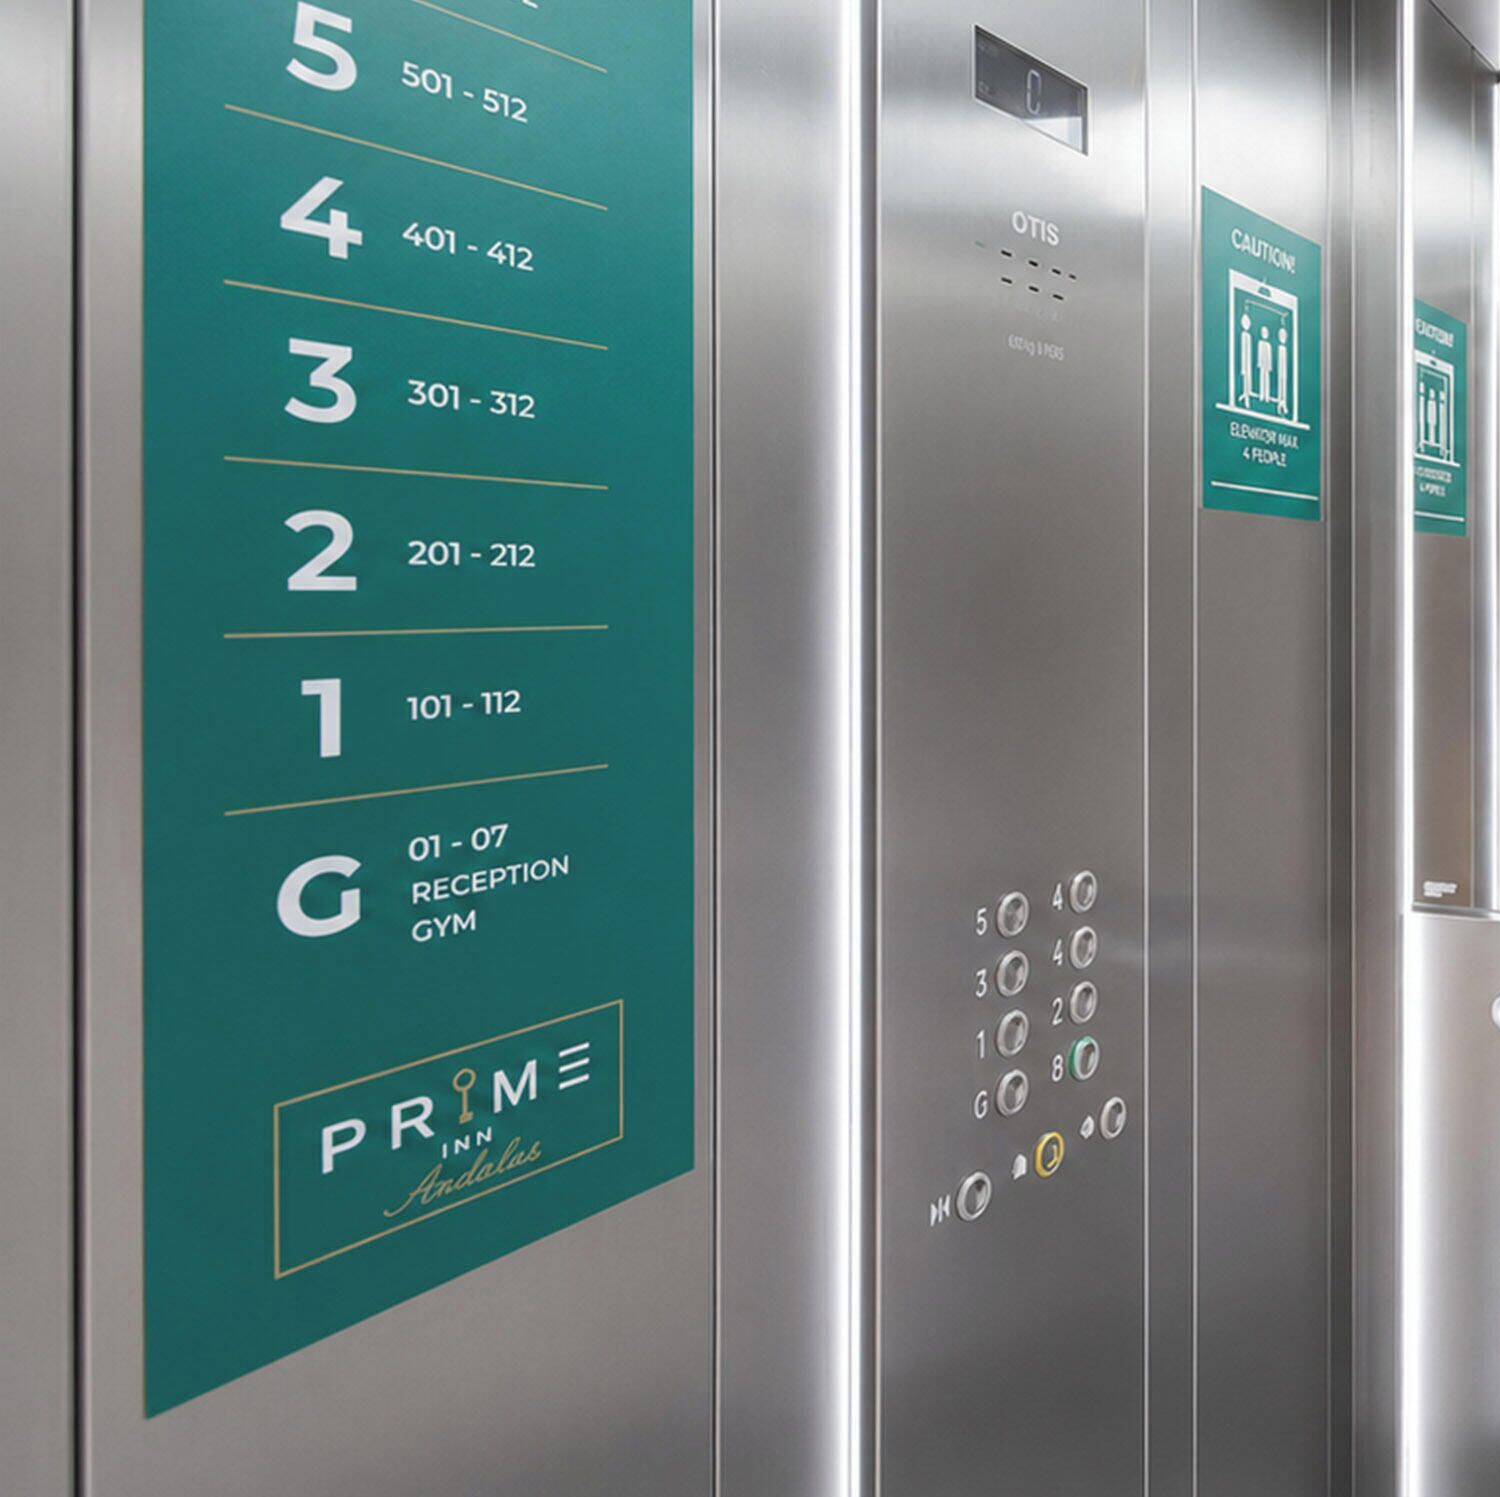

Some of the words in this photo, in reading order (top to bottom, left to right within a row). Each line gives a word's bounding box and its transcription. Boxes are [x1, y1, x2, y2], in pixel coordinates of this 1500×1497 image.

[286, 1, 358, 91] 5
[401, 61, 453, 99] 501
[463, 90, 475, 98] -
[482, 87, 528, 123] 512
[280, 176, 363, 260] 4
[402, 222, 456, 255] 401
[486, 242, 534, 272] 412
[1012, 211, 1060, 246] OTIS
[1231, 228, 1296, 275] CAUTION!
[284, 338, 357, 424] 3
[407, 379, 460, 410] 301
[489, 391, 535, 419] 312
[284, 509, 357, 592] 2
[408, 540, 460, 566] 201
[490, 543, 536, 568] 212
[301, 678, 342, 758] 1
[407, 695, 452, 721] 101
[480, 690, 521, 715] 112
[408, 834, 441, 862] 01
[471, 824, 509, 852] 07
[276, 855, 362, 938] G
[411, 855, 570, 904] RECEPTION
[411, 910, 476, 943] GYM
[976, 908, 987, 935] 5
[976, 969, 987, 997] 3
[1052, 998, 1063, 1025] 2
[977, 1030, 985, 1058] 1
[1051, 1055, 1063, 1081] 8
[321, 1042, 590, 1175] PRIME
[974, 1091, 988, 1119] G
[441, 1126, 493, 1159] INN
[383, 1136, 542, 1218] Andalus
